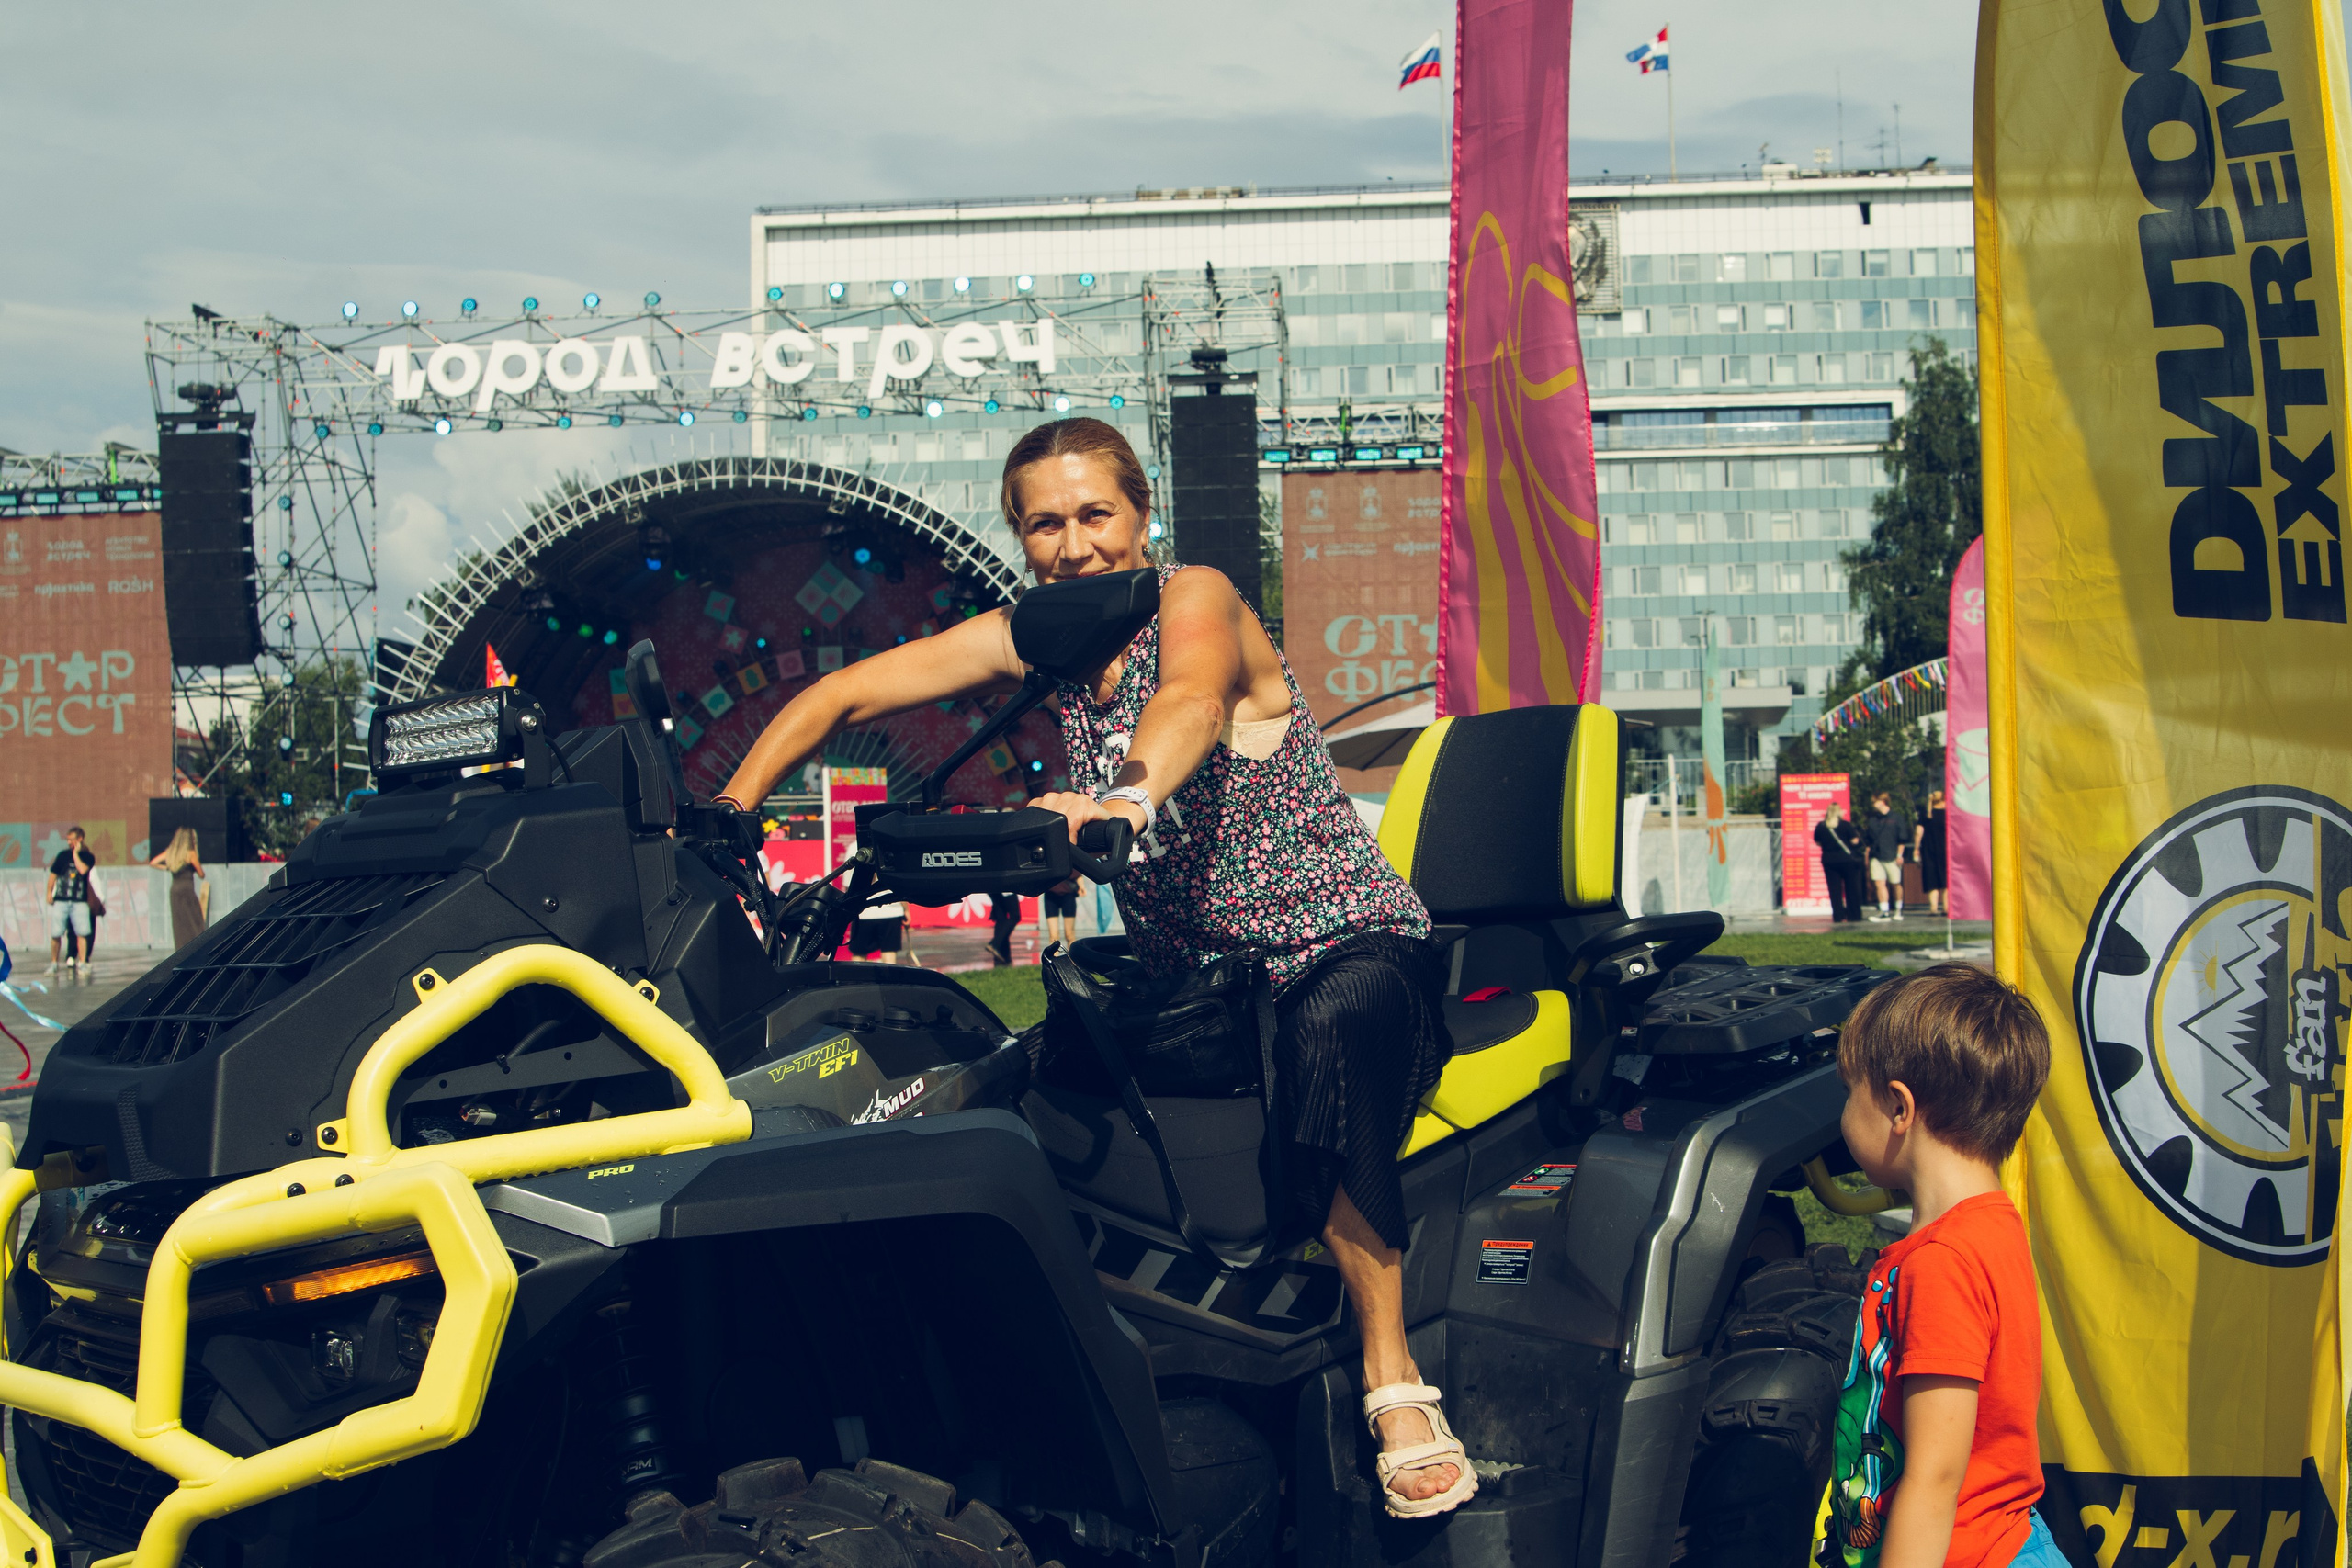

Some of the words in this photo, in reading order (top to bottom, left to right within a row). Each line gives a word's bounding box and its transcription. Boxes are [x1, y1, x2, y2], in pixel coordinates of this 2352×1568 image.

[922, 852, 982, 868] AODES
[2282, 976, 2327, 1082] fan
[768, 1037, 850, 1084] V-TWIN
[818, 1049, 859, 1079] EFI
[883, 1077, 926, 1119] MUD
[587, 1164, 635, 1180] PRO
